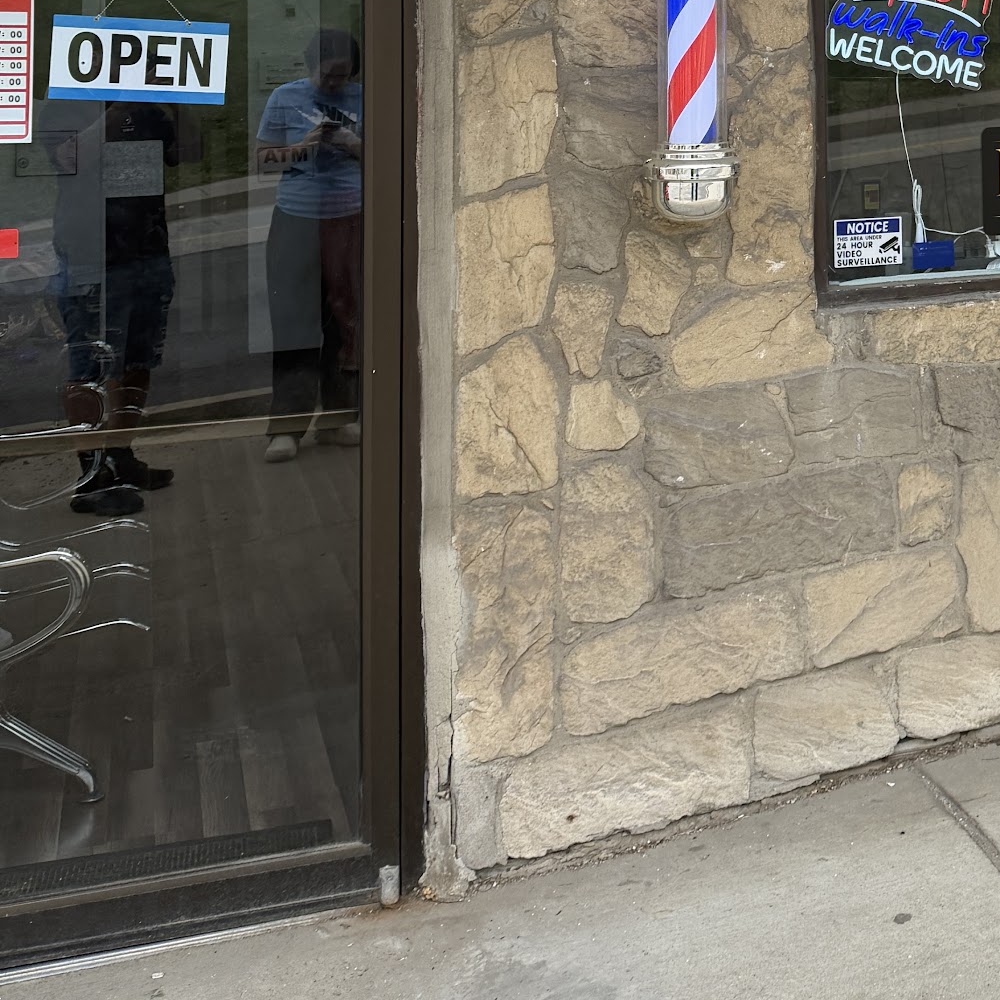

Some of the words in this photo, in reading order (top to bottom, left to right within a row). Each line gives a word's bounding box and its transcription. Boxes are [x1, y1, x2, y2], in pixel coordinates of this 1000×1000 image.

[67, 31, 213, 88] OPEN
[829, 28, 983, 88] WELCOME
[264, 147, 308, 163] ATM
[846, 221, 889, 235] NOTICE
[836, 242, 847, 250] 24
[851, 241, 873, 249] HOUR
[836, 250, 862, 258] VIDEO
[837, 256, 898, 267] SURVEILLANCE
